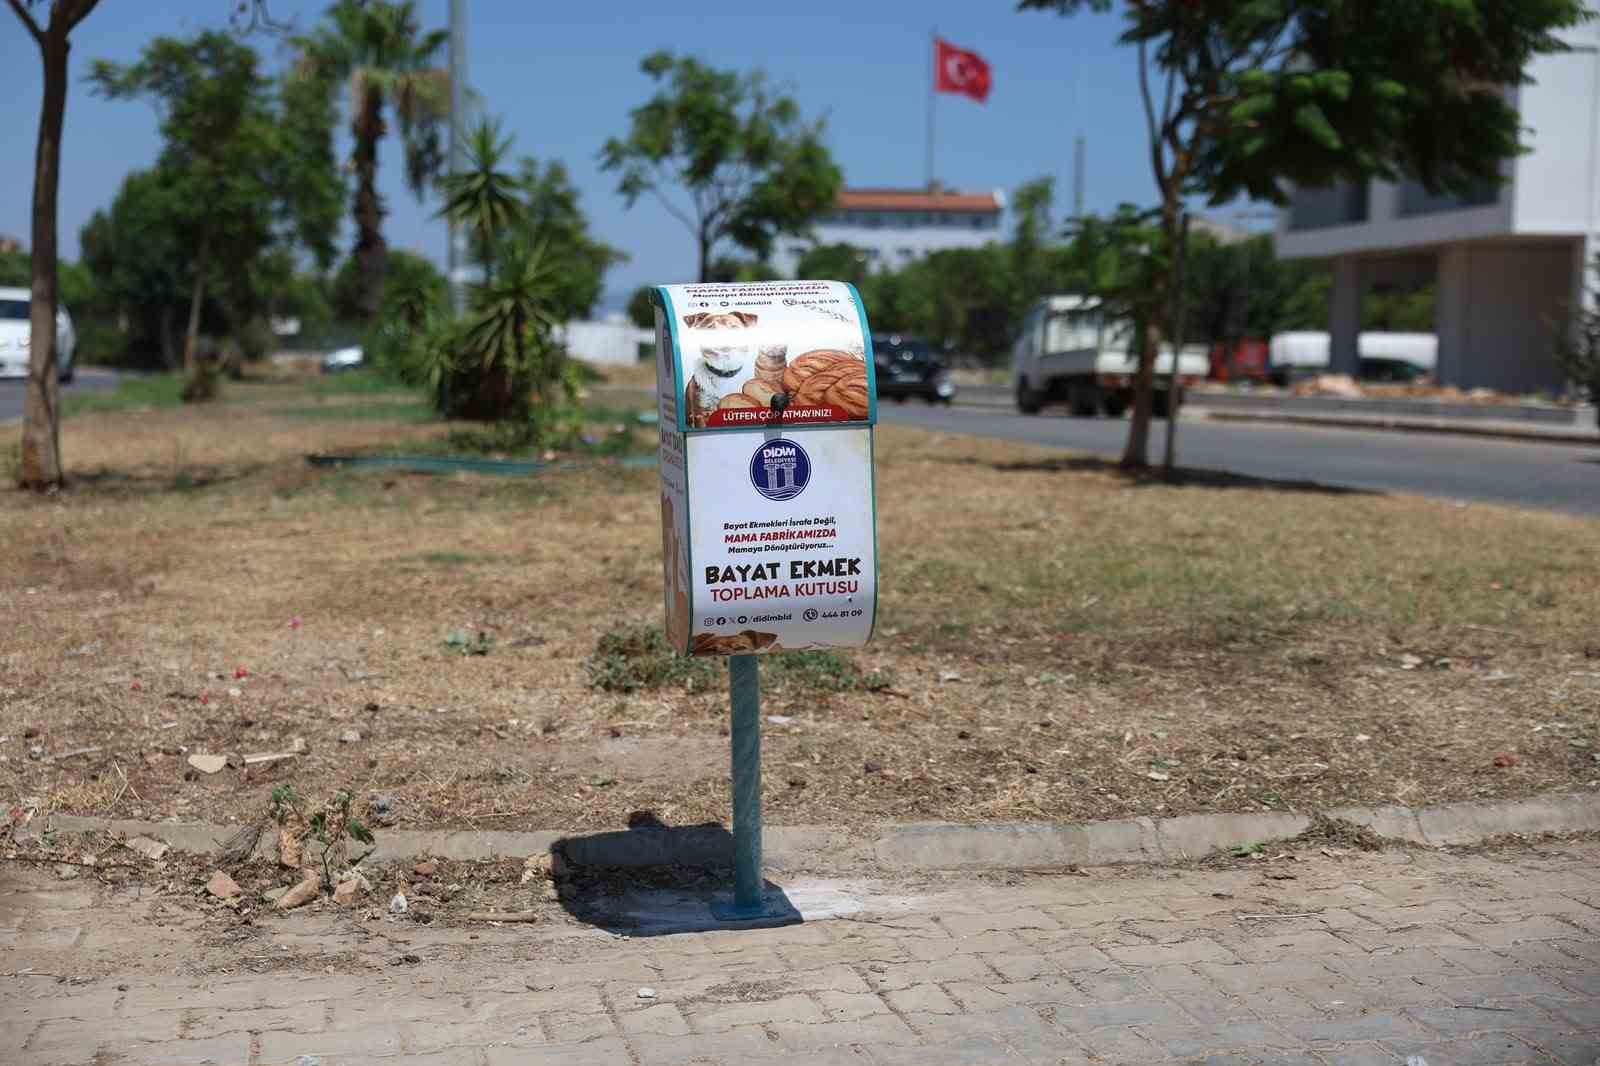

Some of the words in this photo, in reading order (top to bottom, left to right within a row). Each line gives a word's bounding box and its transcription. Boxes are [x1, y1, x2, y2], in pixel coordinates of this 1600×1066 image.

[722, 410, 757, 421] LÜTFEN
[782, 408, 832, 419] ATMAYINIZ!
[762, 446, 796, 458] DİDİM
[723, 522, 748, 531] Bayat
[749, 519, 788, 529] Ekmekleri
[788, 518, 812, 526] İsrafa
[814, 516, 836, 526] Değil,
[724, 531, 758, 544] MAMA
[759, 528, 837, 542] FABRİKAMIZDA
[728, 546, 763, 554] Mamaya
[764, 542, 834, 553] Dönüştürüyoruz...
[705, 562, 780, 584] BAYAT
[790, 558, 862, 579] EKMEK
[710, 586, 789, 602] TOPLAMA
[795, 580, 858, 597] KUTUSU
[822, 610, 838, 618] 444
[840, 610, 850, 618] 81
[851, 608, 862, 618] 09
